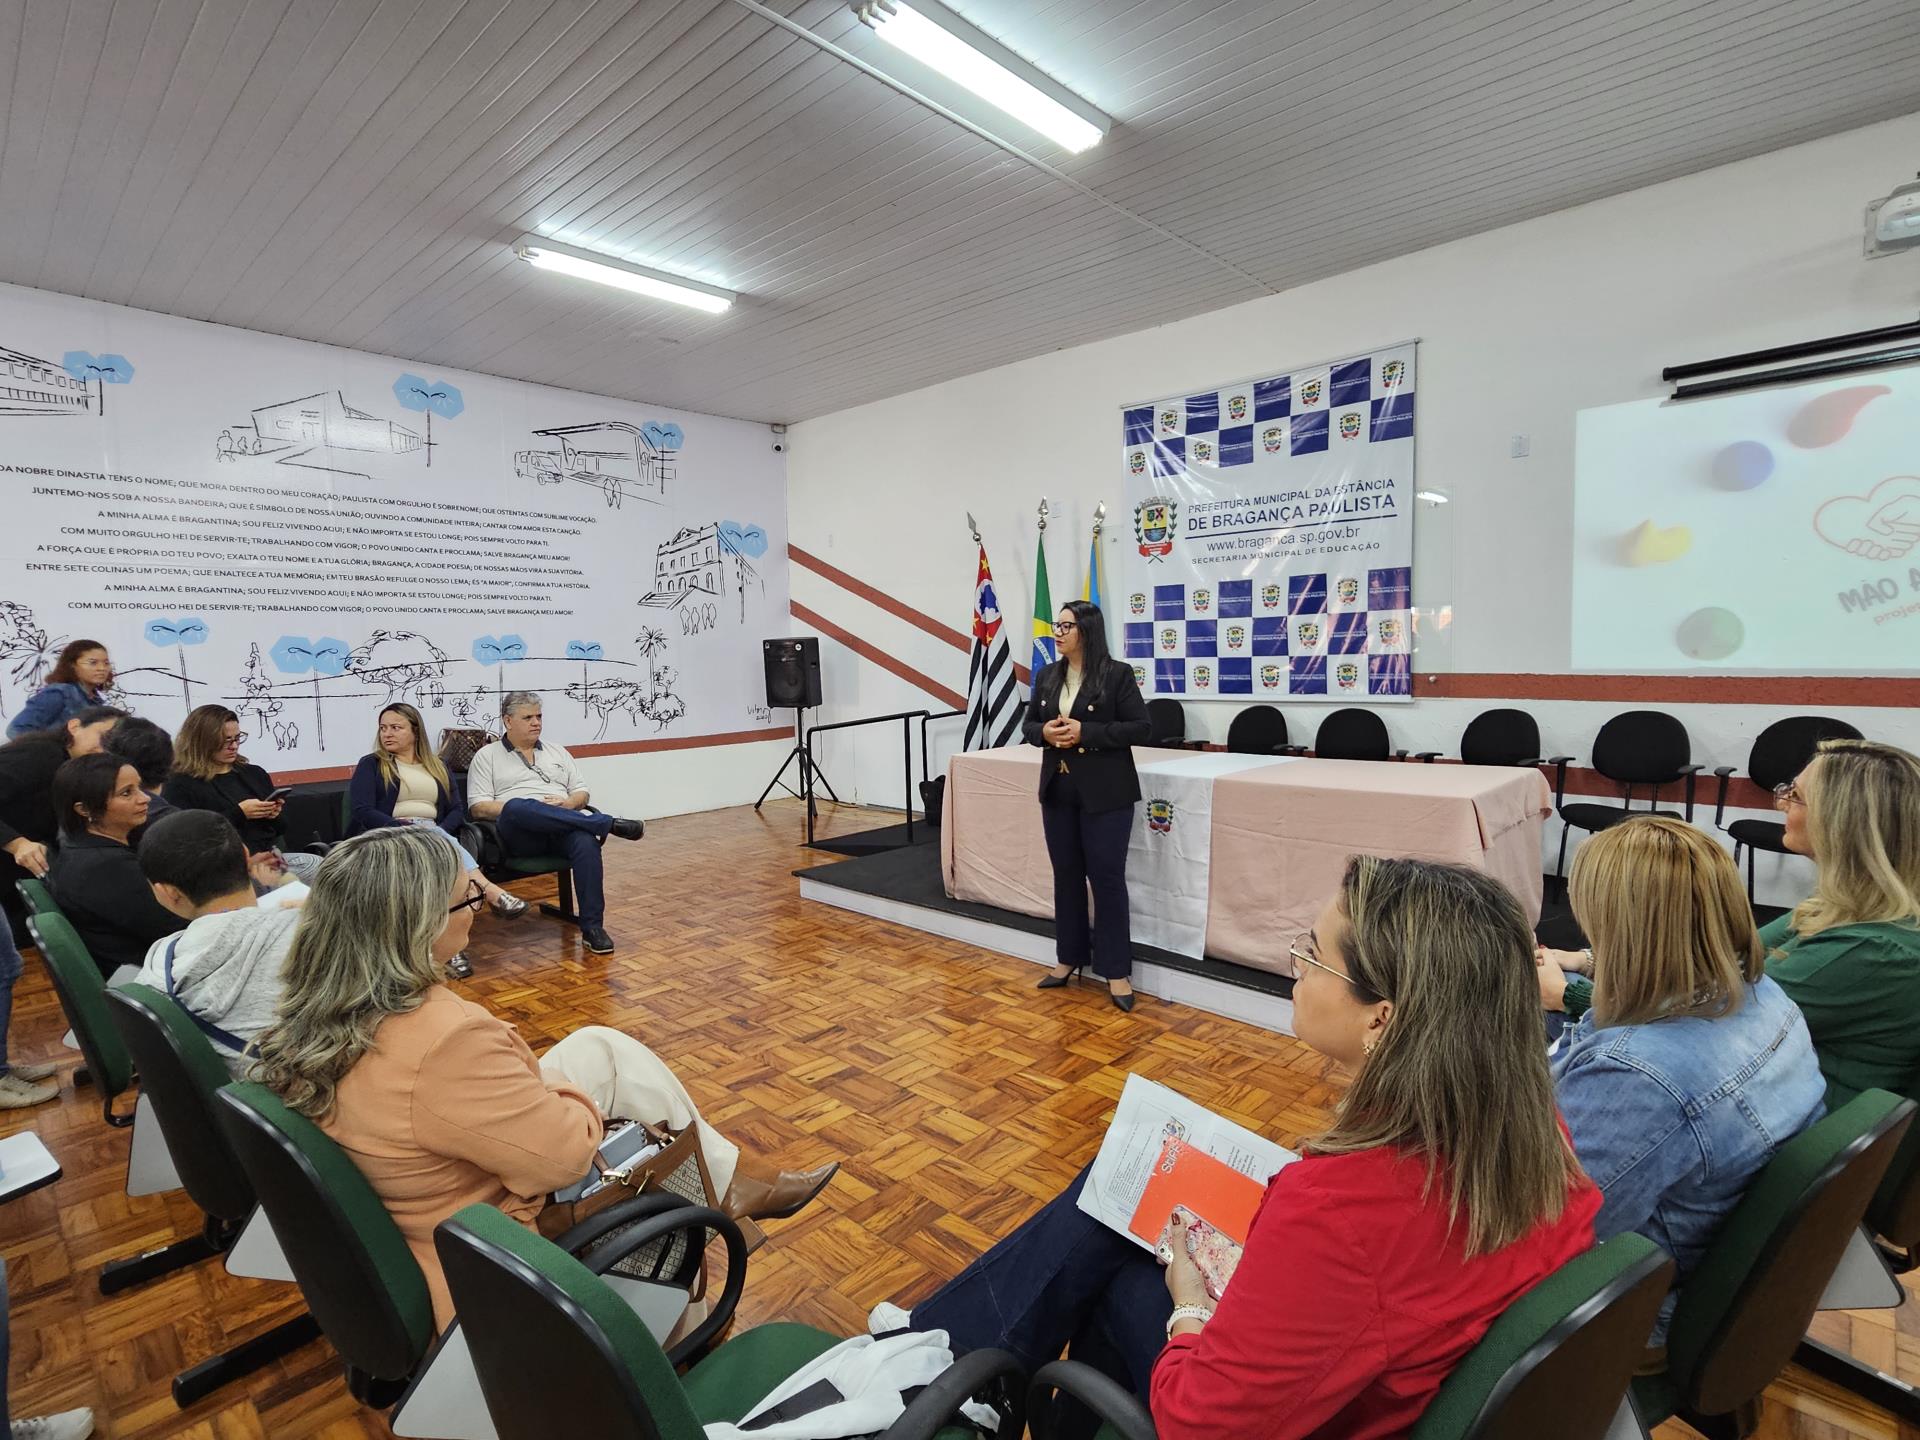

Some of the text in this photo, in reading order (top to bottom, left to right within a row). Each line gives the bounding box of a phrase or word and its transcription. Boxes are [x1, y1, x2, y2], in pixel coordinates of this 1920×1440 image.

[16, 466, 54, 476] NOBRE
[57, 470, 106, 480] DINASTIA
[108, 474, 133, 482] TENS
[145, 478, 176, 488] NOME;
[178, 480, 198, 488] QUE
[200, 482, 227, 491] MORA
[230, 485, 265, 494] DENTRO
[282, 489, 299, 497] MEU
[342, 495, 378, 503] PAULISTA
[396, 500, 431, 508] ORGULHO
[32, 486, 110, 499] JUNTEMO-NOS
[143, 496, 177, 504] NOSSA
[179, 498, 227, 509] BANDEIRA;
[308, 508, 335, 516] NOSSA
[364, 512, 399, 520] OUVINDO
[407, 515, 453, 525] COMUNIDADE
[1188, 498, 1250, 514] PREFEITURA
[1254, 490, 1311, 506] MUNICIPAL
[1315, 488, 1331, 498] DA
[1188, 494, 1394, 531] DE BRAGANÇA PAULISTA
[179, 516, 240, 527] BRAGANTINA;
[285, 523, 322, 531] VIVENDO
[88, 528, 120, 536] MUITO
[122, 530, 170, 539] ORGULHO
[204, 535, 250, 544] SERVIR-TE;
[251, 537, 314, 547] TRABALHANDO
[1207, 526, 1360, 552] www.braganca.sp.gov.br
[47, 545, 82, 554] FORÇA
[197, 552, 225, 560] POVO;
[1192, 554, 1248, 564] SECRETARIA
[1250, 550, 1302, 560] MUNICIPAL
[1320, 542, 1380, 554] EDUCAÇÃO
[26, 563, 61, 571] ENTRE
[154, 568, 190, 576] POEMA;
[185, 586, 245, 595] BRAGANTINA;
[209, 604, 255, 612] SERVIR-TE;
